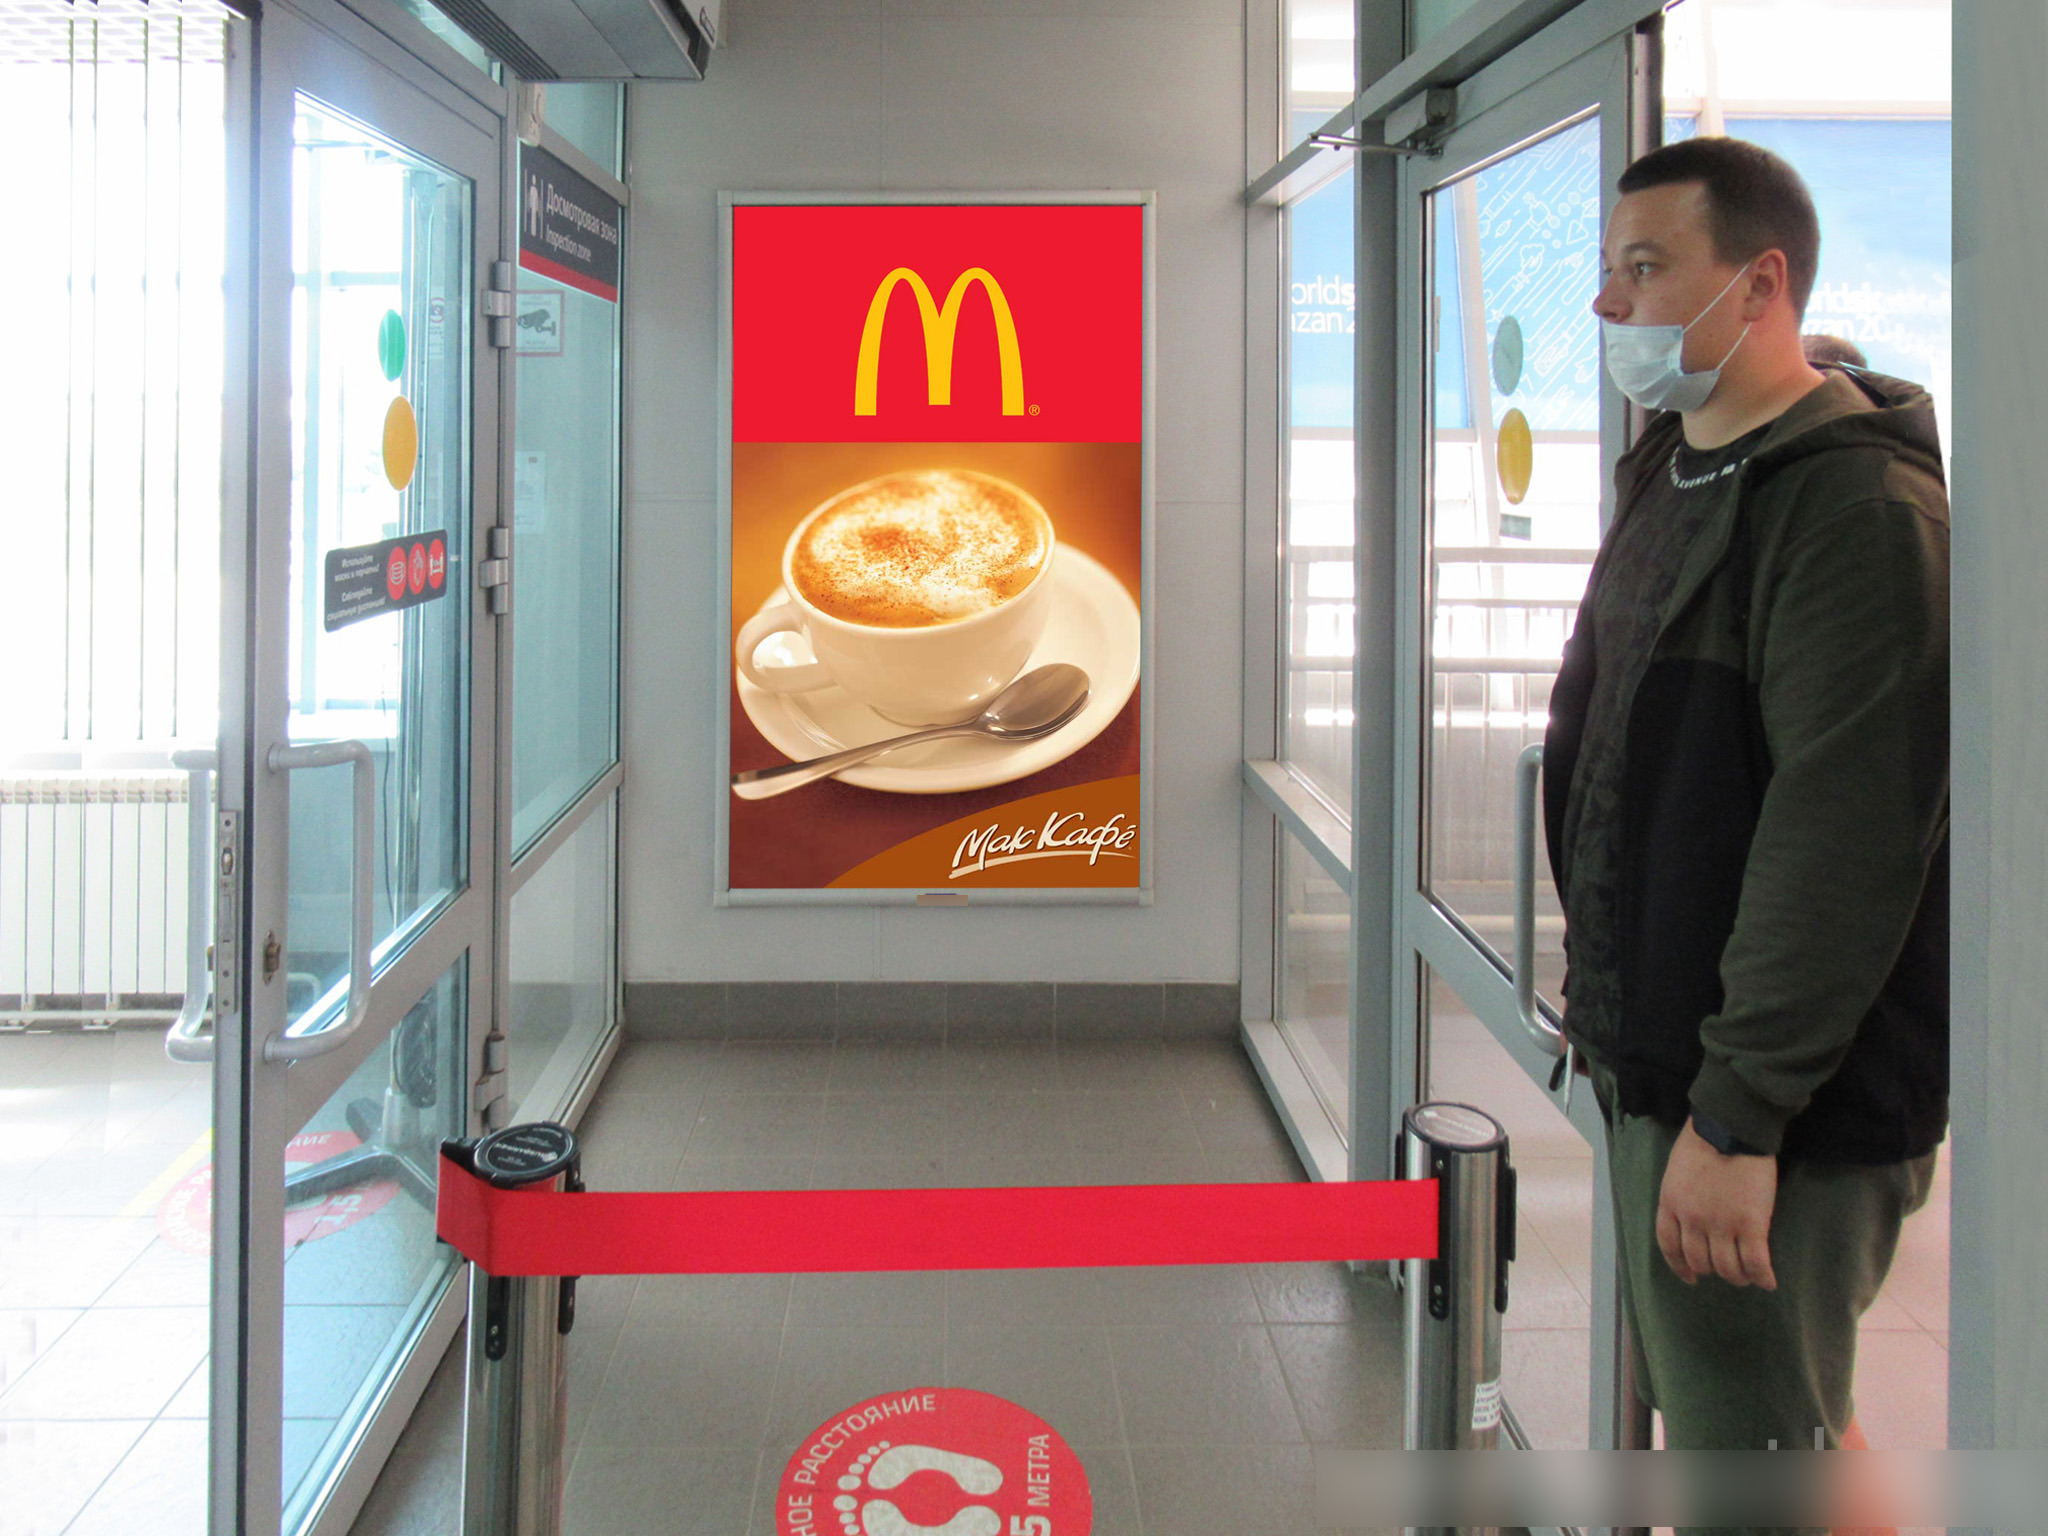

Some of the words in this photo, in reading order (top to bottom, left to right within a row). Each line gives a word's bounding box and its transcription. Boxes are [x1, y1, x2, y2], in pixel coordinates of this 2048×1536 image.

[545, 223, 577, 256] Inspection
[577, 243, 592, 263] zone
[546, 183, 600, 235] Досмотровая
[600, 220, 617, 246] зона
[793, 1394, 936, 1486] РАССТОЯНИЕ
[1027, 1433, 1051, 1508] МЕТРА
